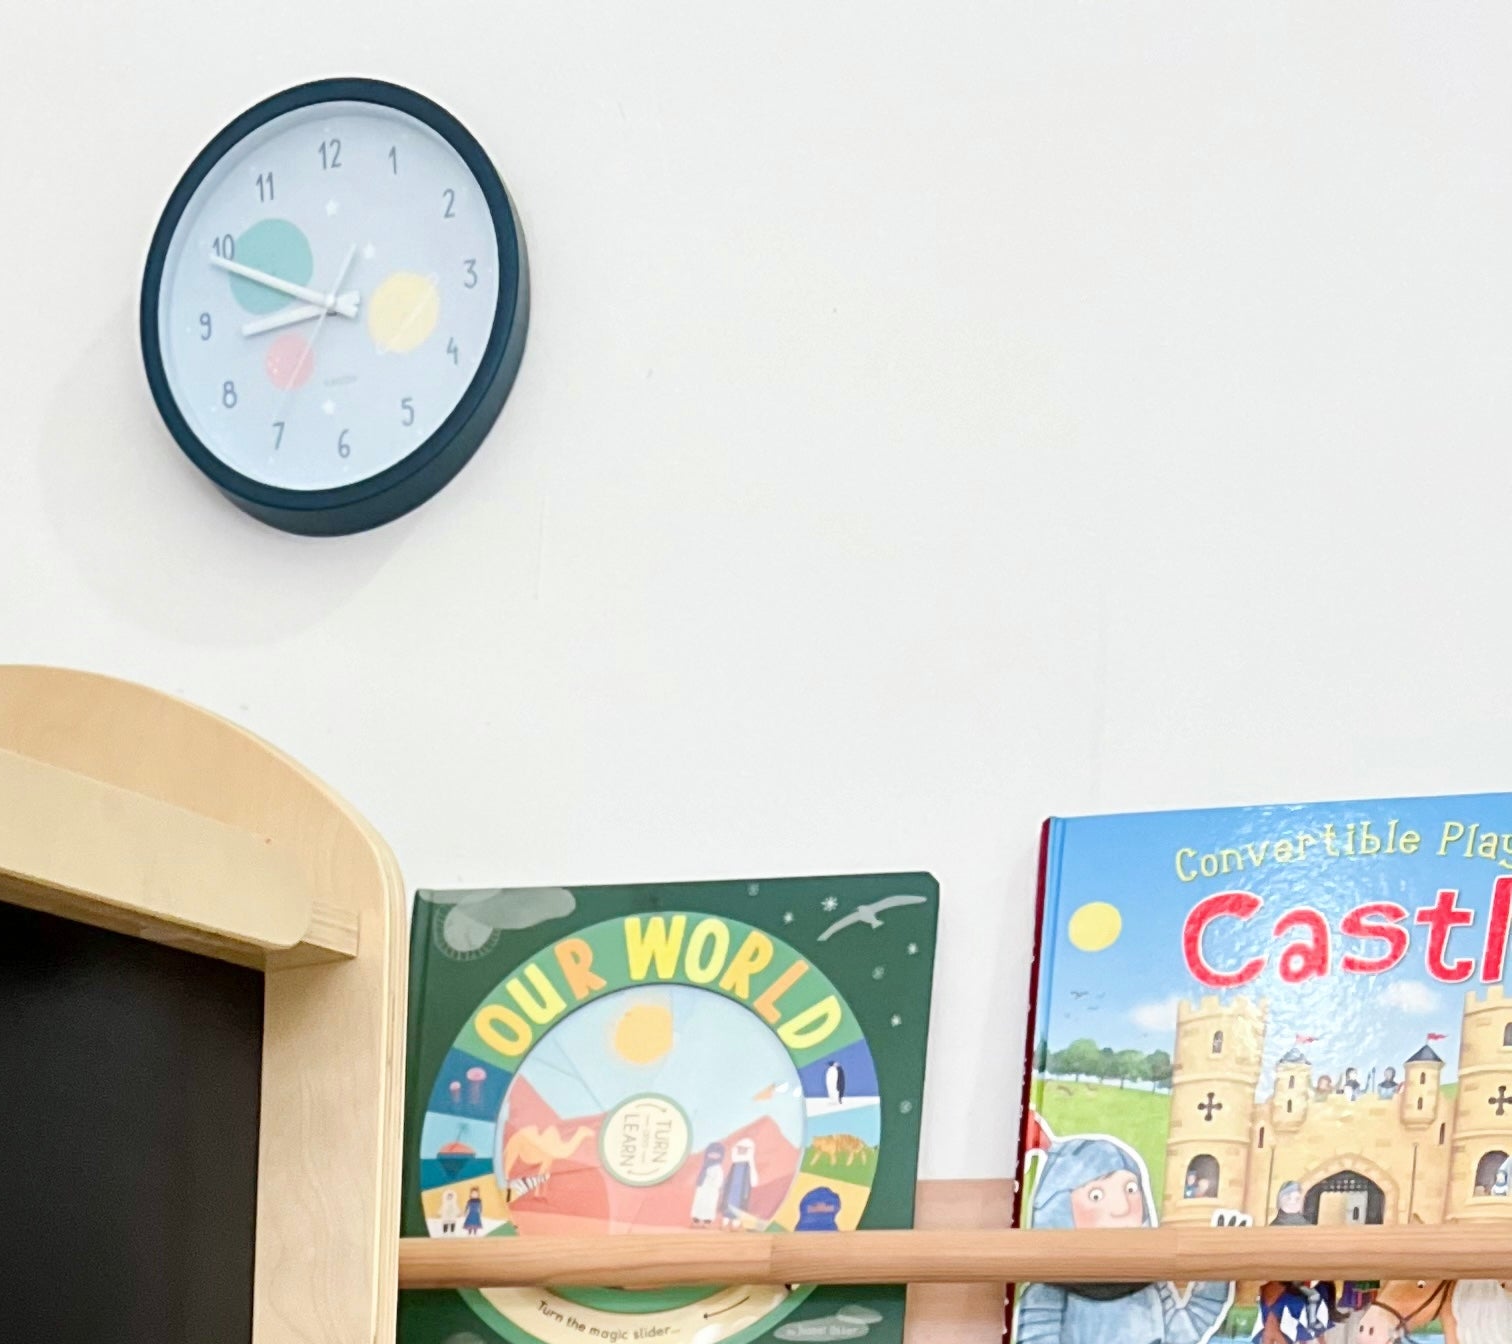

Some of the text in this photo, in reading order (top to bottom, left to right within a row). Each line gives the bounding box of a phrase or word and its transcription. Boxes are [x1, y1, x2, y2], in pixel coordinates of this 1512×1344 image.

[318, 138, 342, 170] 12
[387, 146, 399, 175] 1
[256, 172, 275, 202] 11
[442, 188, 456, 218] 2
[464, 258, 478, 289] 3
[199, 312, 212, 341] 9
[446, 337, 459, 365] 4
[222, 380, 237, 409] 8
[400, 397, 415, 427] 5
[272, 422, 286, 451] 7
[337, 429, 351, 459] 6
[1175, 818, 1420, 883] Convertible
[474, 915, 842, 1057] OUR WORLD
[619, 1114, 641, 1167] LEARN
[652, 1119, 672, 1163] TURN
[538, 1300, 564, 1324] Turn
[566, 1317, 586, 1333] the
[588, 1326, 629, 1344] magic
